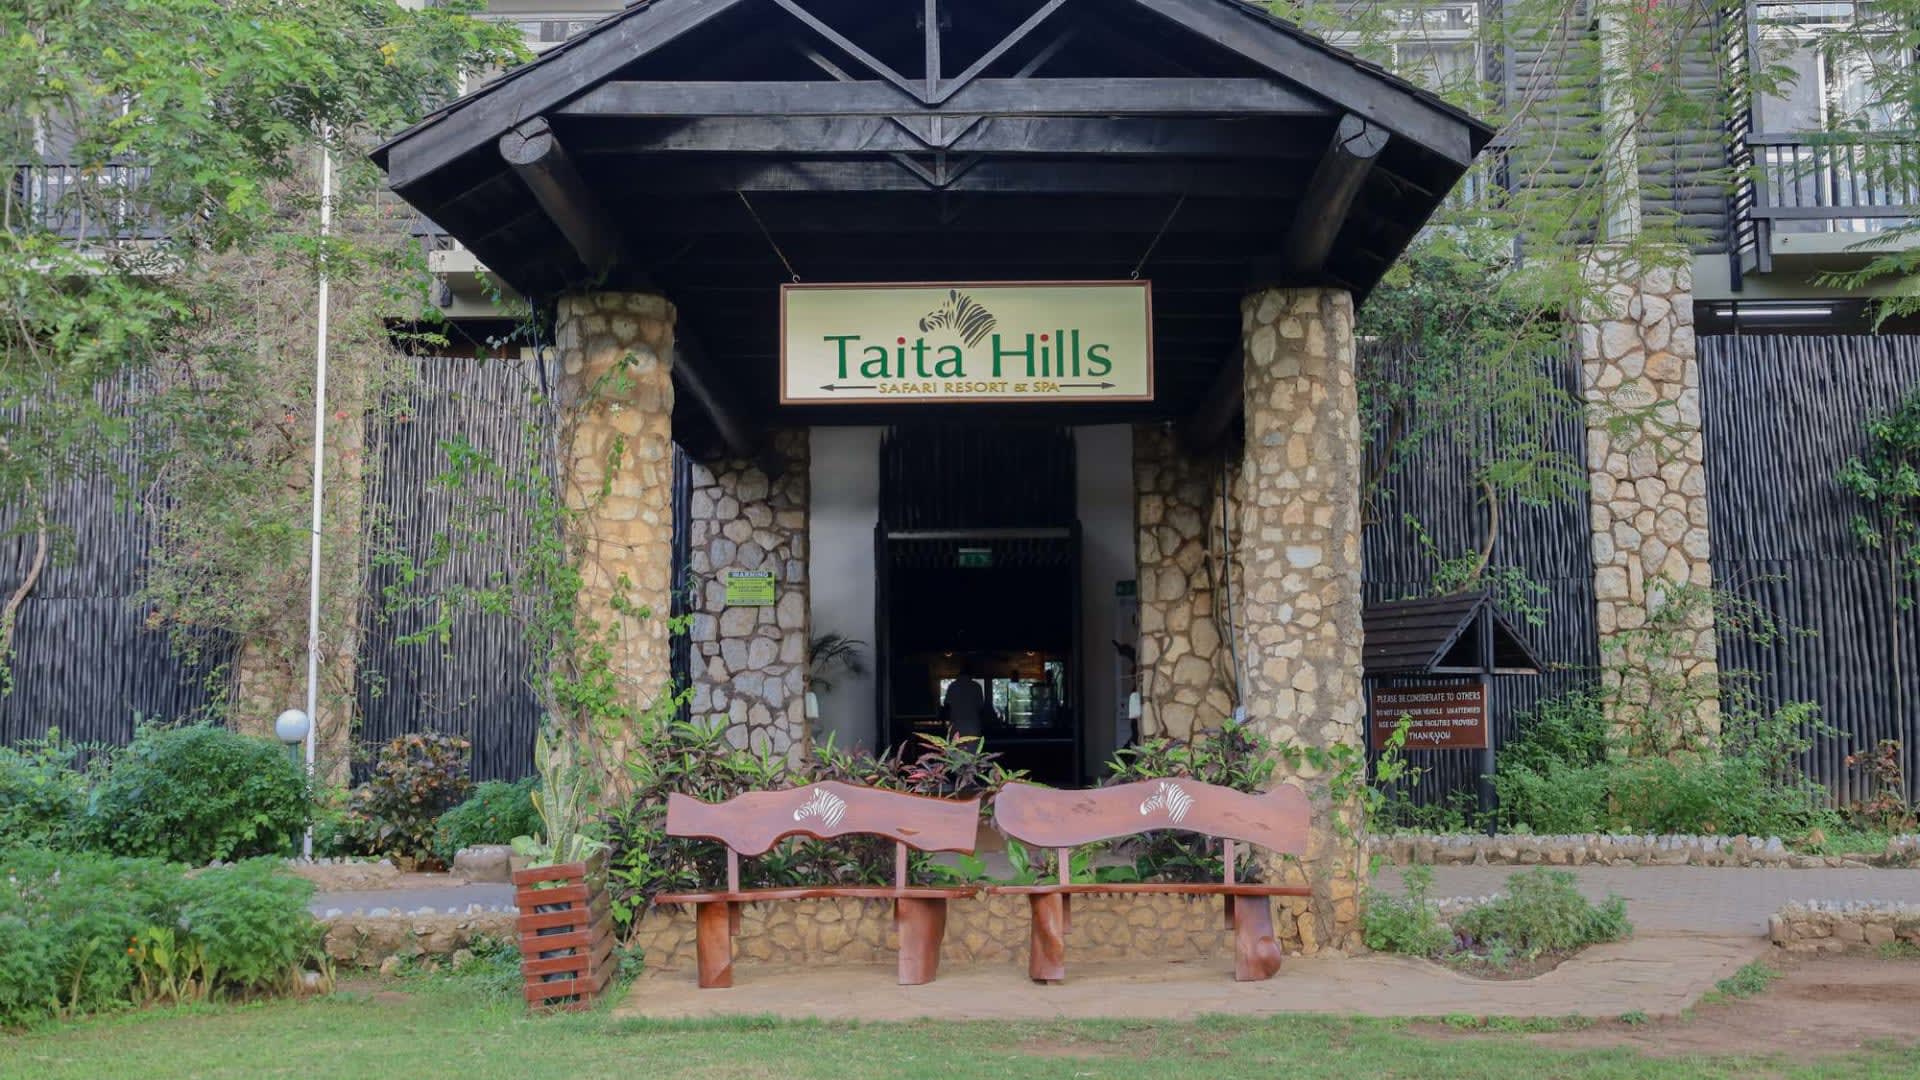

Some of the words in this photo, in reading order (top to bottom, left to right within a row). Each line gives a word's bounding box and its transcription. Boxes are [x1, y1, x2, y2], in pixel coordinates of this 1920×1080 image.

[823, 335, 967, 379] Taita
[991, 329, 1113, 378] Hills
[879, 382, 937, 394] SAFARI
[944, 382, 1008, 393] RESORT
[1014, 382, 1028, 393] &
[1033, 381, 1060, 392] SPA
[1376, 695, 1398, 703] PLEASE
[1399, 694, 1406, 702] BE
[1407, 693, 1445, 702] CONSIDERATE
[1446, 693, 1455, 701] TO
[1456, 691, 1481, 700] OTHERS
